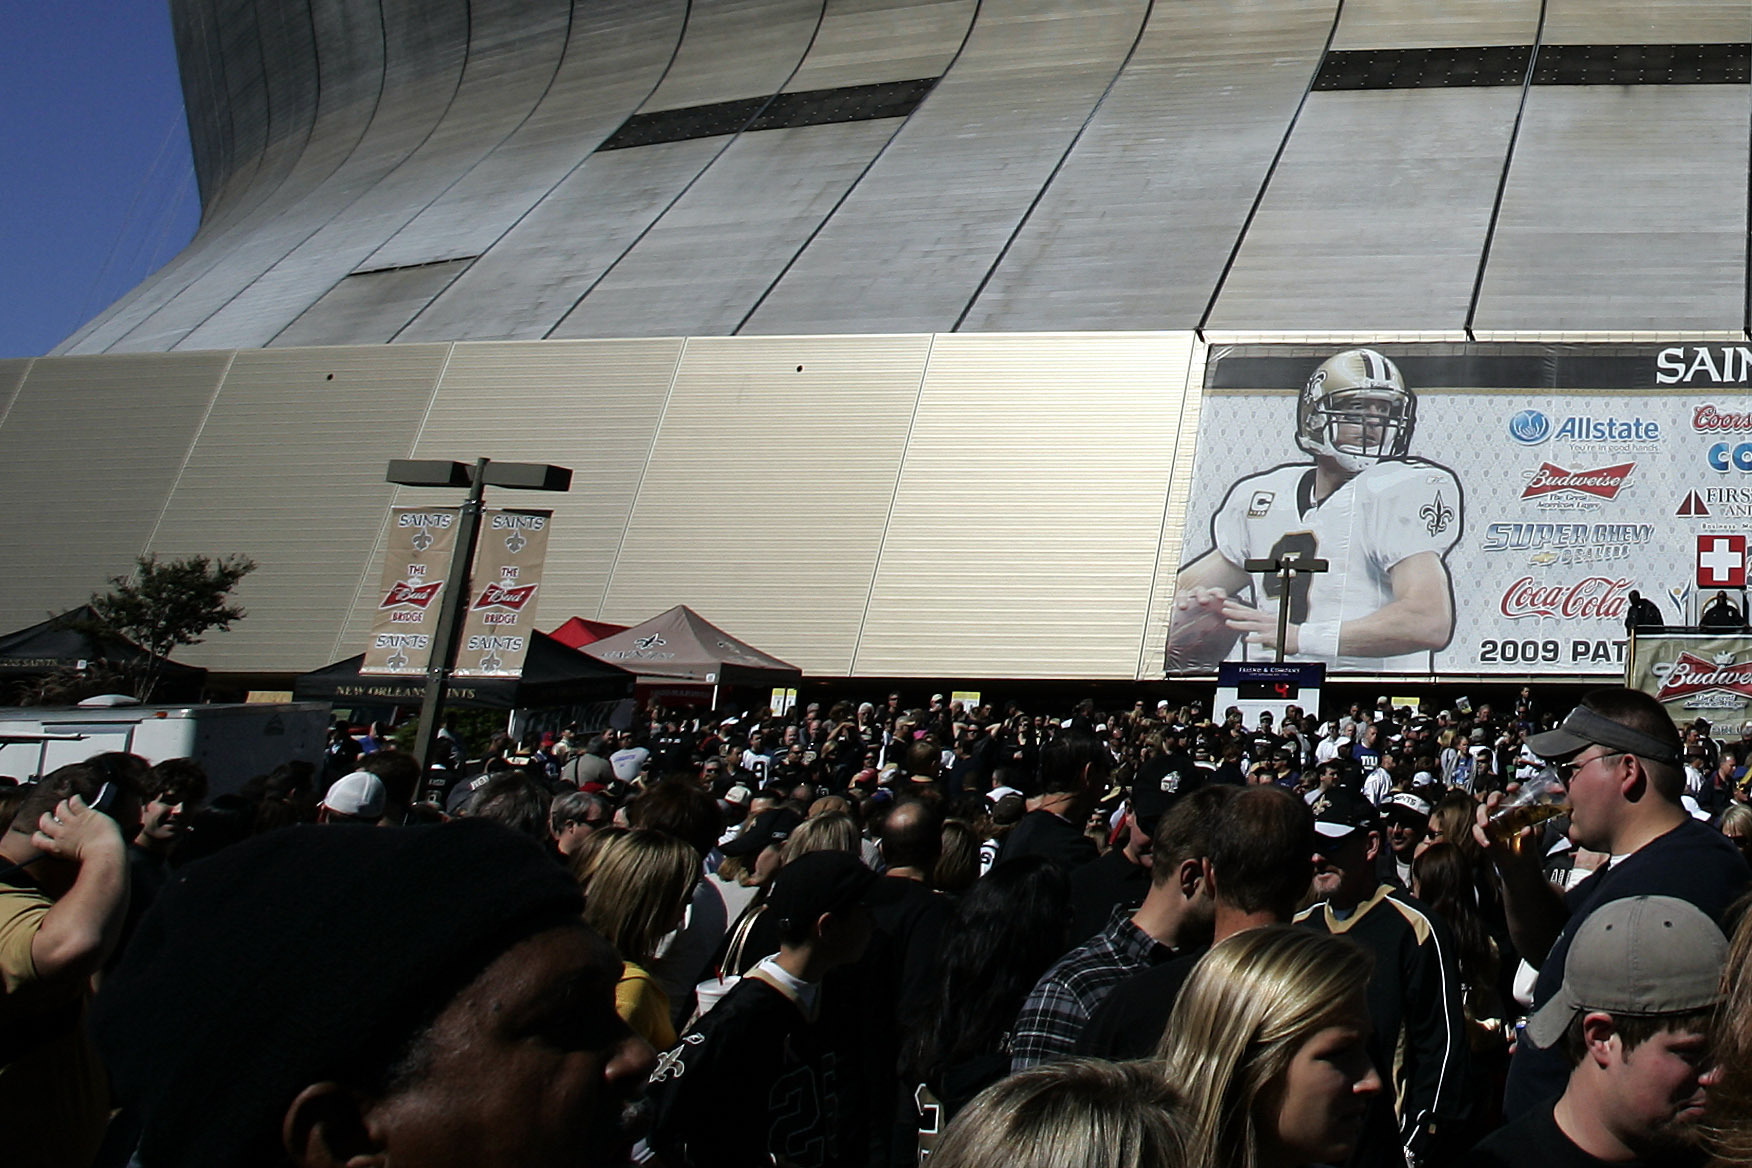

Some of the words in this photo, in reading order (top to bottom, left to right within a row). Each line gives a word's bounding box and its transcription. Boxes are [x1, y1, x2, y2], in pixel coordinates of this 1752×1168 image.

[1693, 405, 1752, 430] Coors
[1555, 417, 1660, 440] Allstate
[1570, 443, 1595, 452] You're
[1598, 443, 1606, 451] in
[1608, 444, 1630, 453] good
[1522, 468, 1634, 490] Budweiser
[399, 514, 451, 528] SAINTS
[492, 515, 545, 529] SAINTS
[1484, 523, 1588, 549] SUPER
[1590, 524, 1655, 545] CHEVY
[1561, 546, 1630, 563] DEALERS
[408, 565, 426, 575] THE
[501, 567, 519, 577] THE
[394, 587, 430, 601] Bud
[487, 588, 523, 602] Bud
[1501, 576, 1636, 619] Coca-Cola
[392, 612, 423, 622] BRIDGE
[484, 614, 517, 624] BRIDGE
[376, 635, 428, 648] SAINTS
[469, 637, 523, 650] SAINTS
[1480, 640, 1560, 663] 2009
[1571, 640, 1628, 662] PAT
[336, 686, 364, 695] NEW
[368, 686, 427, 697] ORLEANS
[446, 688, 476, 699] INTS
